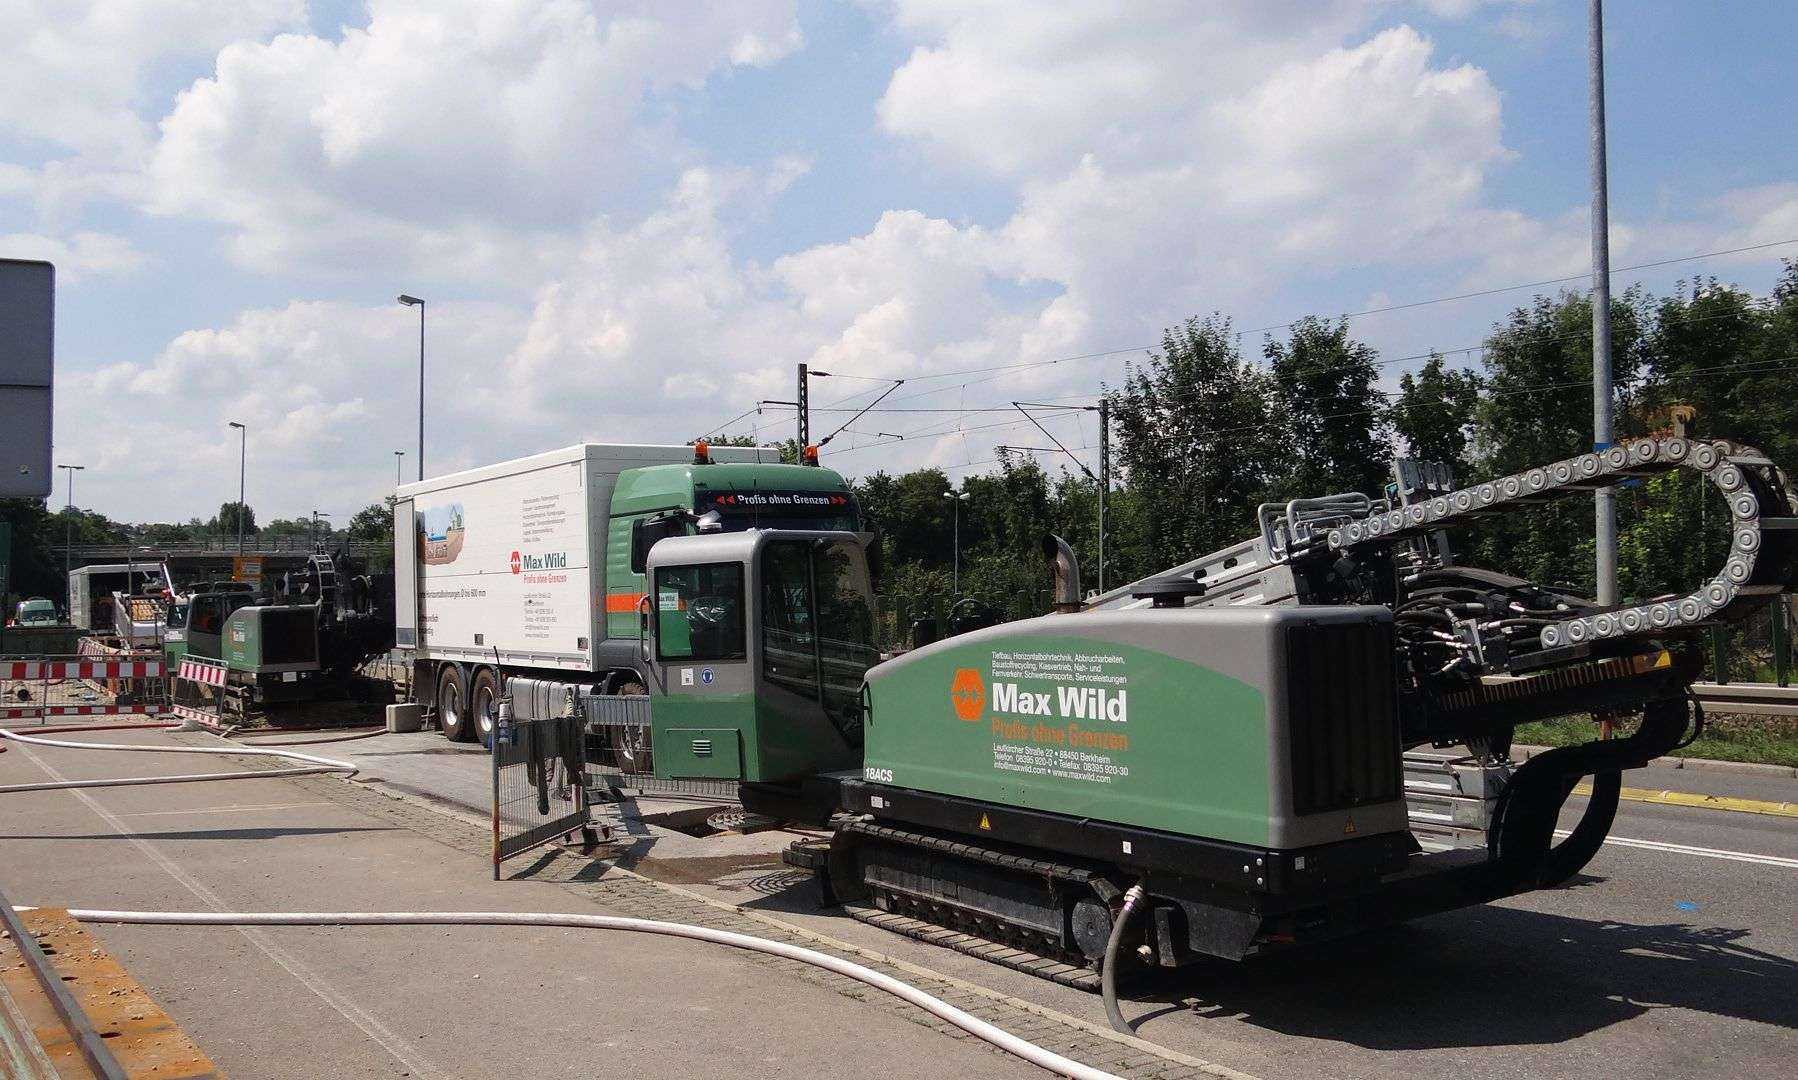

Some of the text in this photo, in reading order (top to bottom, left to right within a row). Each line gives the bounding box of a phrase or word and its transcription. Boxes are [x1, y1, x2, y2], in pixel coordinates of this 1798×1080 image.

[737, 494, 830, 505] Profis ohne Grenzen
[523, 552, 567, 570] Max Wild
[1074, 654, 1125, 664] Abbrucharbeiten,
[1089, 664, 1102, 672] und
[1075, 673, 1127, 685] Serviceleistungen
[992, 682, 1127, 722] Max Wild
[1045, 749, 1054, 758] 22
[865, 767, 893, 782] 18ACS
[1104, 765, 1129, 776] 920-30
[1052, 769, 1112, 784] www.maxwild.com
